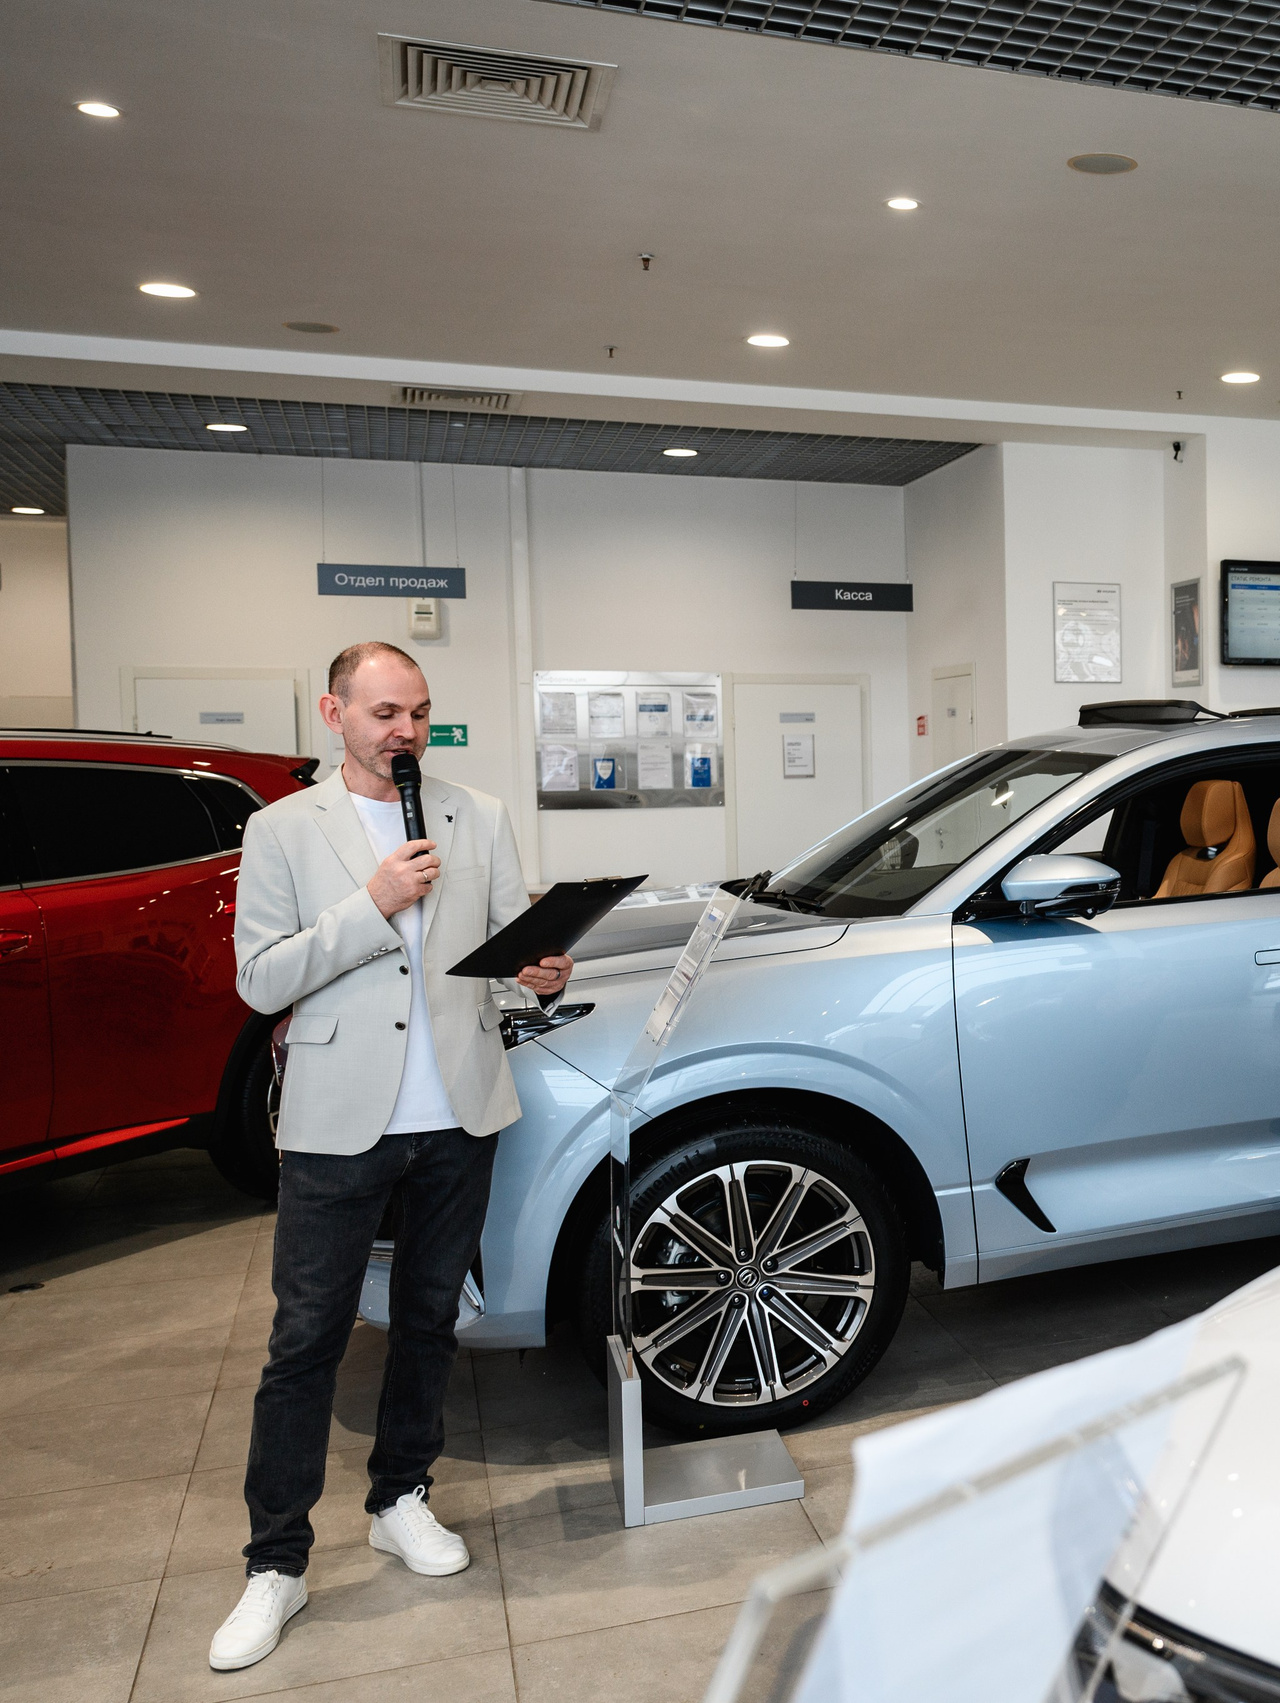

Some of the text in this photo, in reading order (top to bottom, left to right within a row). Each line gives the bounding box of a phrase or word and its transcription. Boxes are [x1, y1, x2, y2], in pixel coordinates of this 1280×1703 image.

[334, 572, 449, 590] Отдел продаж
[834, 588, 873, 601] Касса
